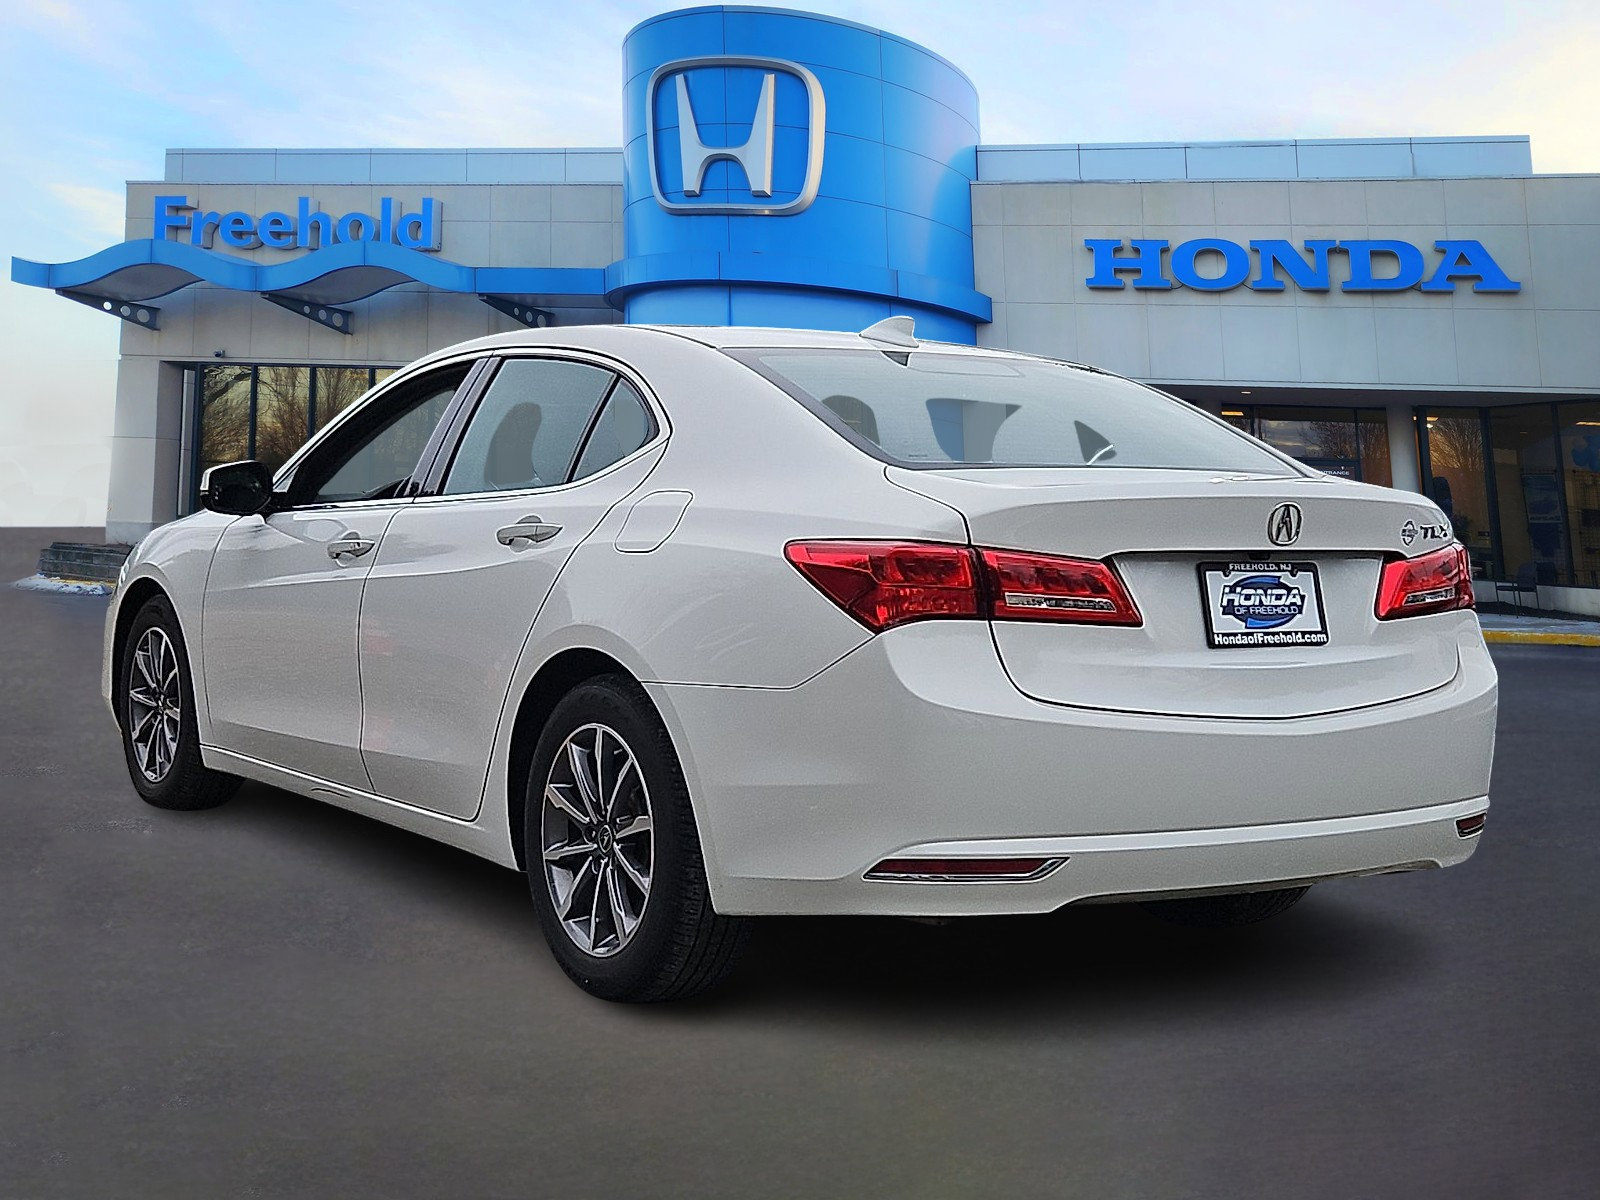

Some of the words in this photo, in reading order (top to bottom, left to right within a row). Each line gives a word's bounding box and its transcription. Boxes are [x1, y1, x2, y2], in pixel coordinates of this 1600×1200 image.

[153, 195, 441, 251] Freehold
[1084, 238, 1522, 293] HONDA
[1420, 524, 1449, 540] TLX
[1280, 563, 1292, 571] NJ
[1221, 586, 1302, 606] HONDA
[1234, 606, 1249, 615] OF
[1249, 606, 1299, 615] FREEHOLD
[1214, 632, 1328, 645] HondaofFreehold.com
